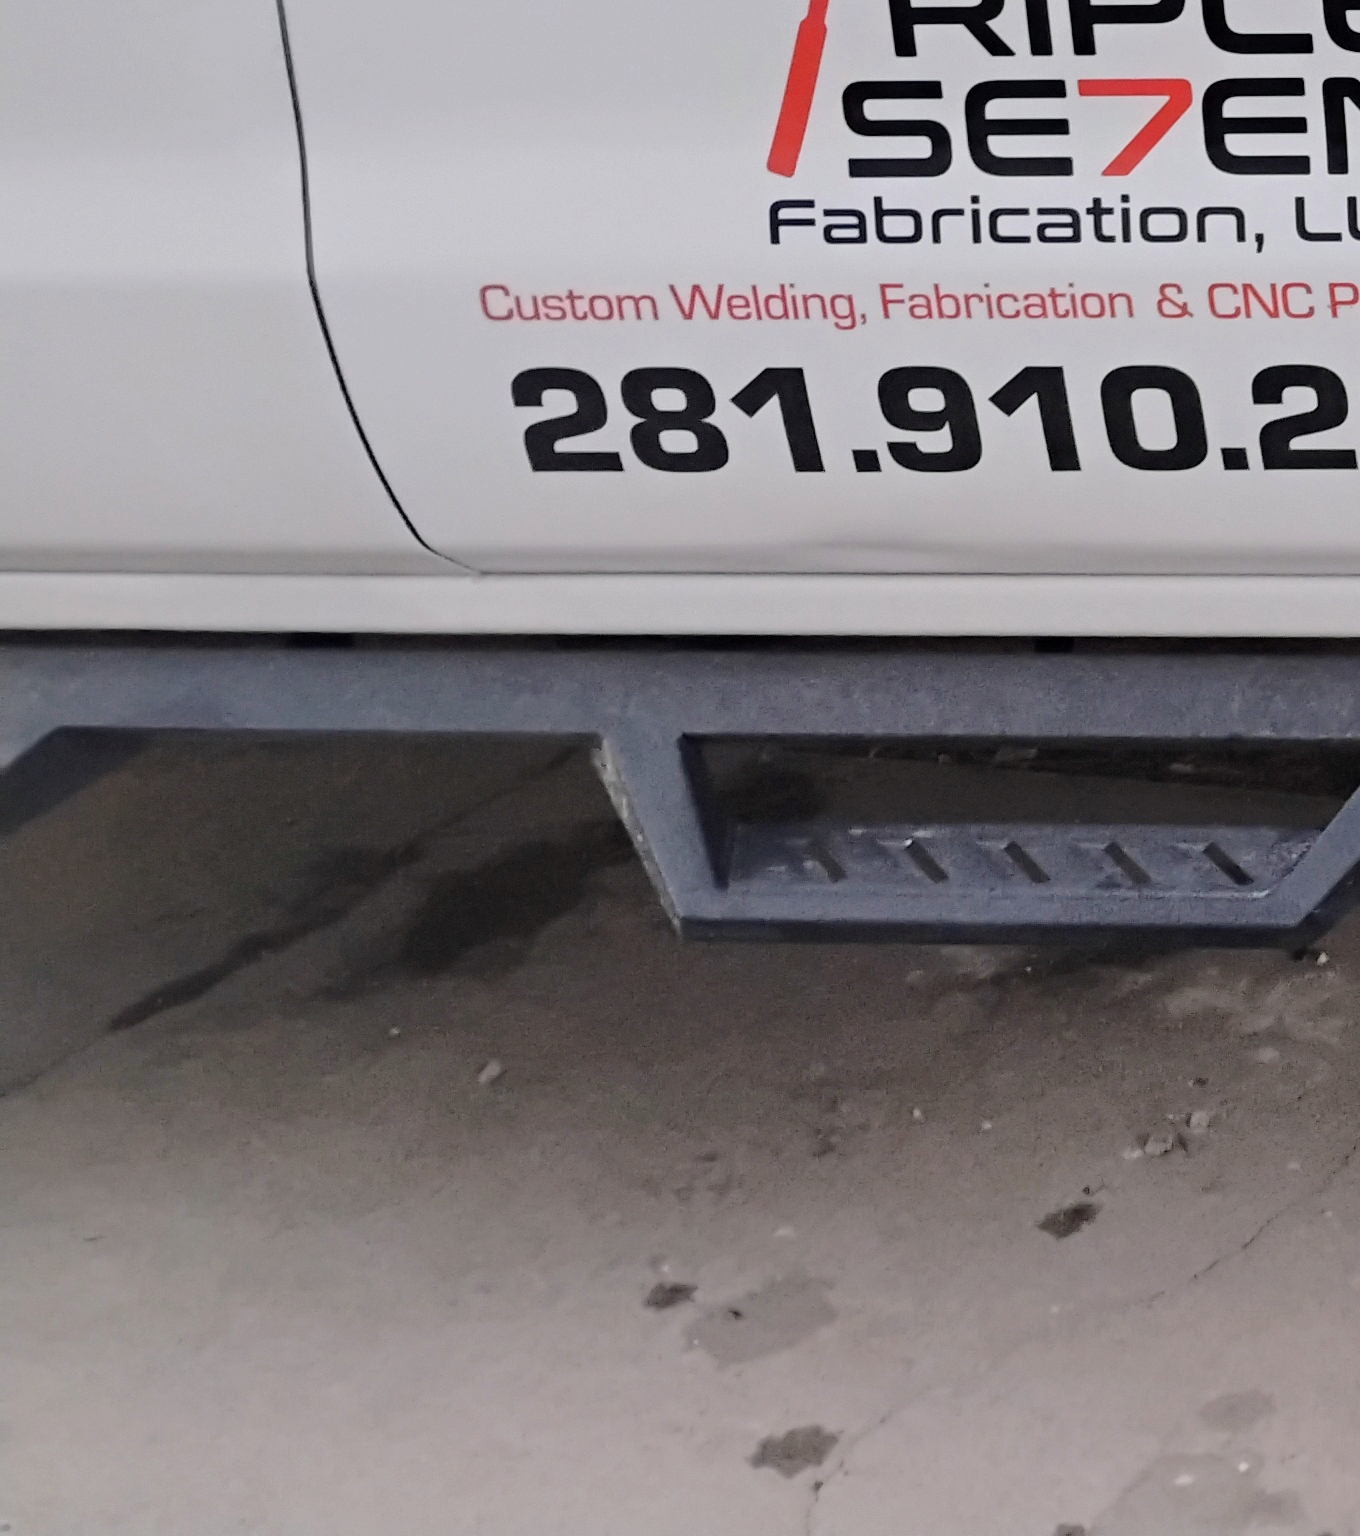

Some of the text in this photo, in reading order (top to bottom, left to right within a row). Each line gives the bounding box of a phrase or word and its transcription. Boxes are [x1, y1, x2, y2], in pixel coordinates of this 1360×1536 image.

[768, 198, 1265, 254] Fabrication,
[479, 284, 660, 321] Custom
[668, 283, 868, 331] Welding,
[879, 283, 1134, 320] Fabrication
[1156, 282, 1194, 319] &
[1207, 281, 1316, 320] CNC
